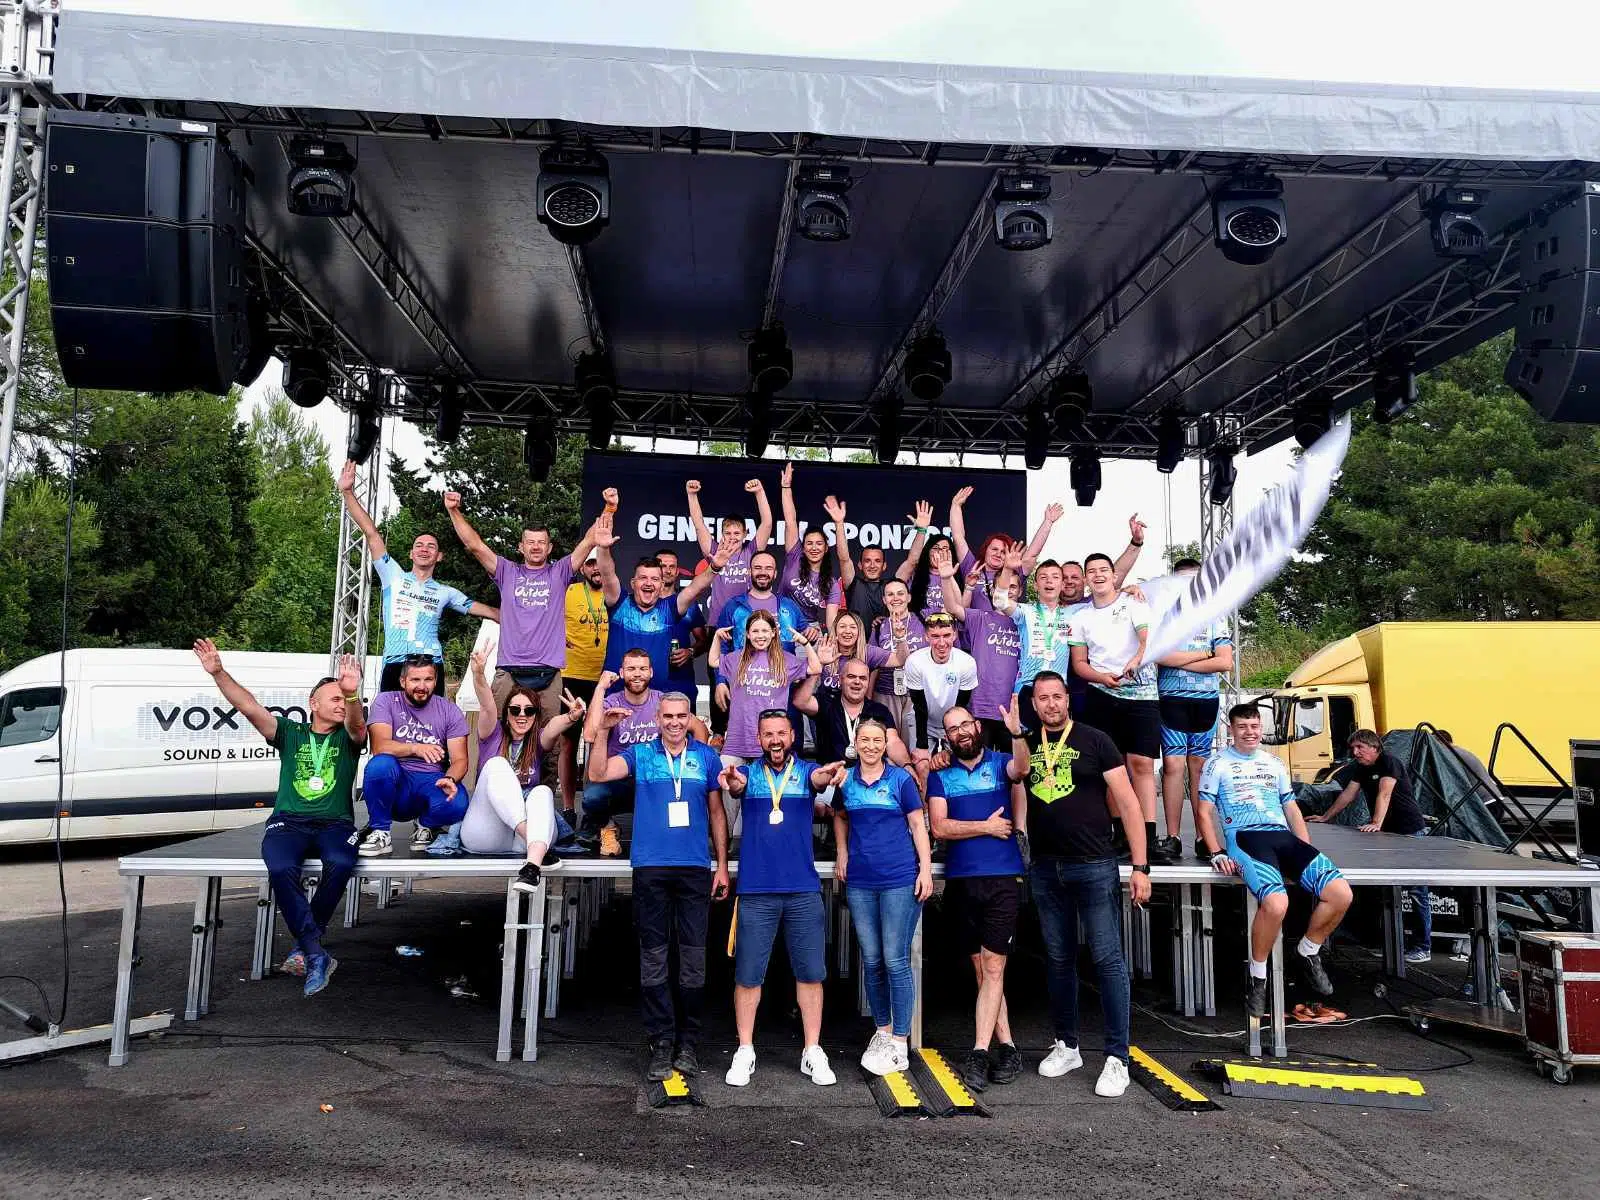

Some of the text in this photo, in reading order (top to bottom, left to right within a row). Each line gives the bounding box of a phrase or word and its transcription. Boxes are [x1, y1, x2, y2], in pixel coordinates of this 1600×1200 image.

[153, 706, 239, 731] VOX
[163, 748, 276, 761] SOUND & LIGH
